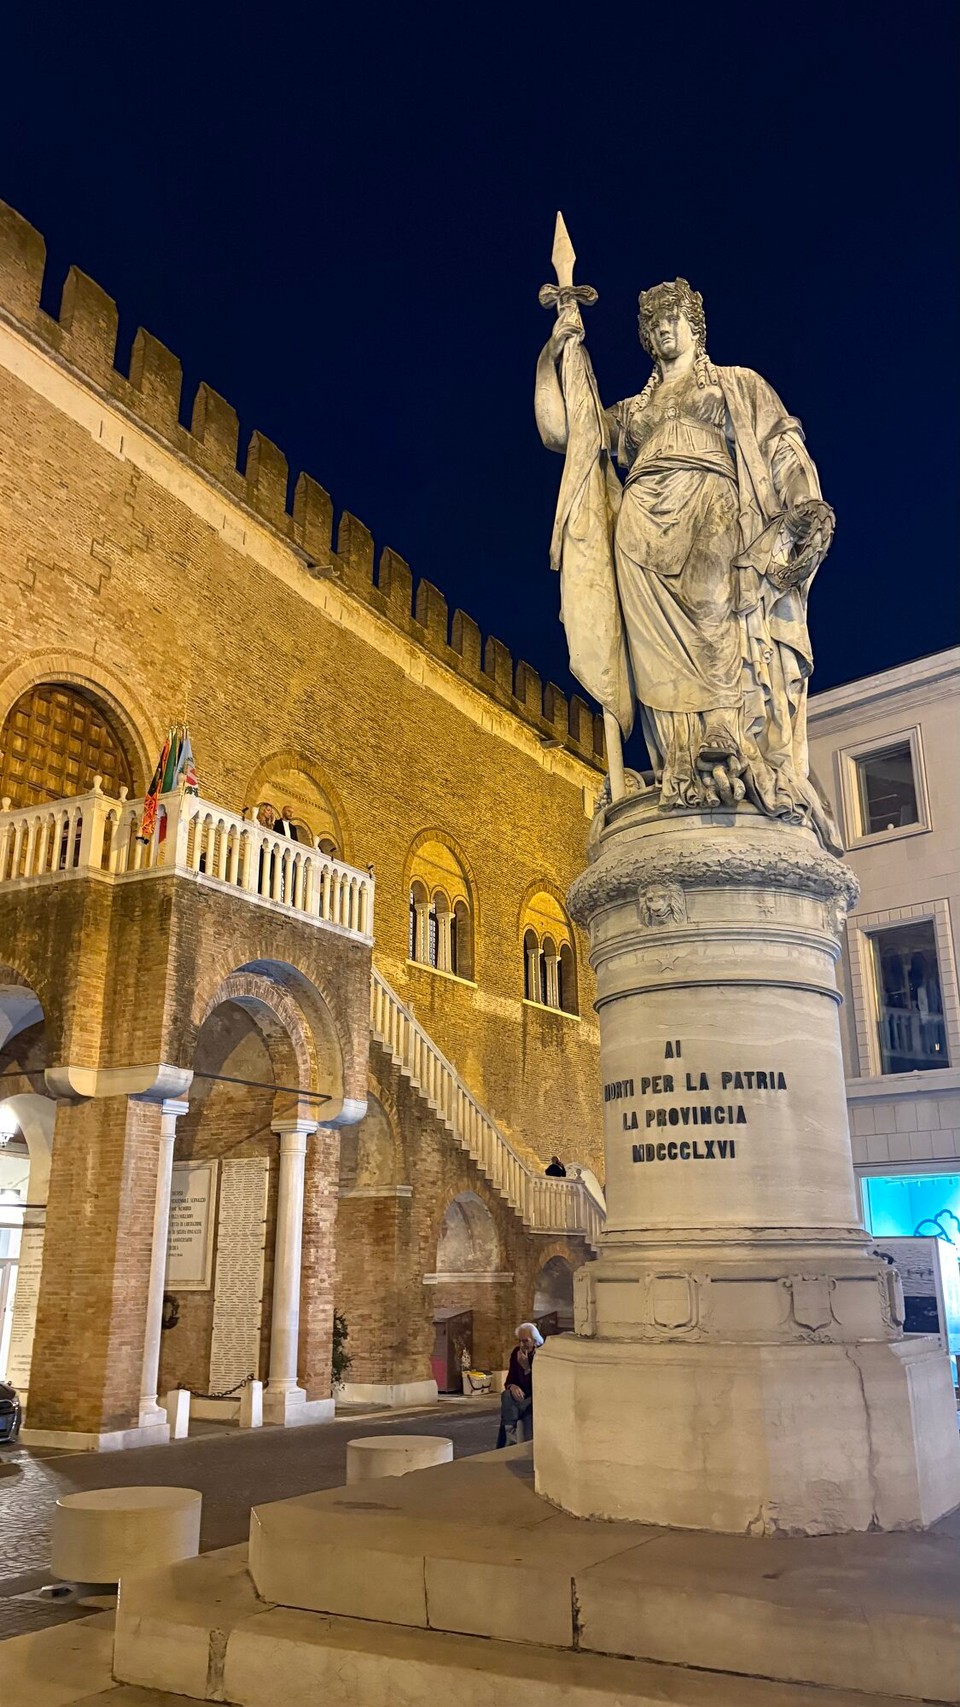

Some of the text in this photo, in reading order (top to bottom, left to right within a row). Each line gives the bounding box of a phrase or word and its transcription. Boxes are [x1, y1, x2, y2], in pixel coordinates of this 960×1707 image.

[664, 1039, 682, 1059] AI
[604, 1071, 787, 1102] MORTI PER LA PATRIA
[622, 1105, 747, 1131] LA PROVINCIA
[632, 1139, 736, 1163] MDCCCLXVI
